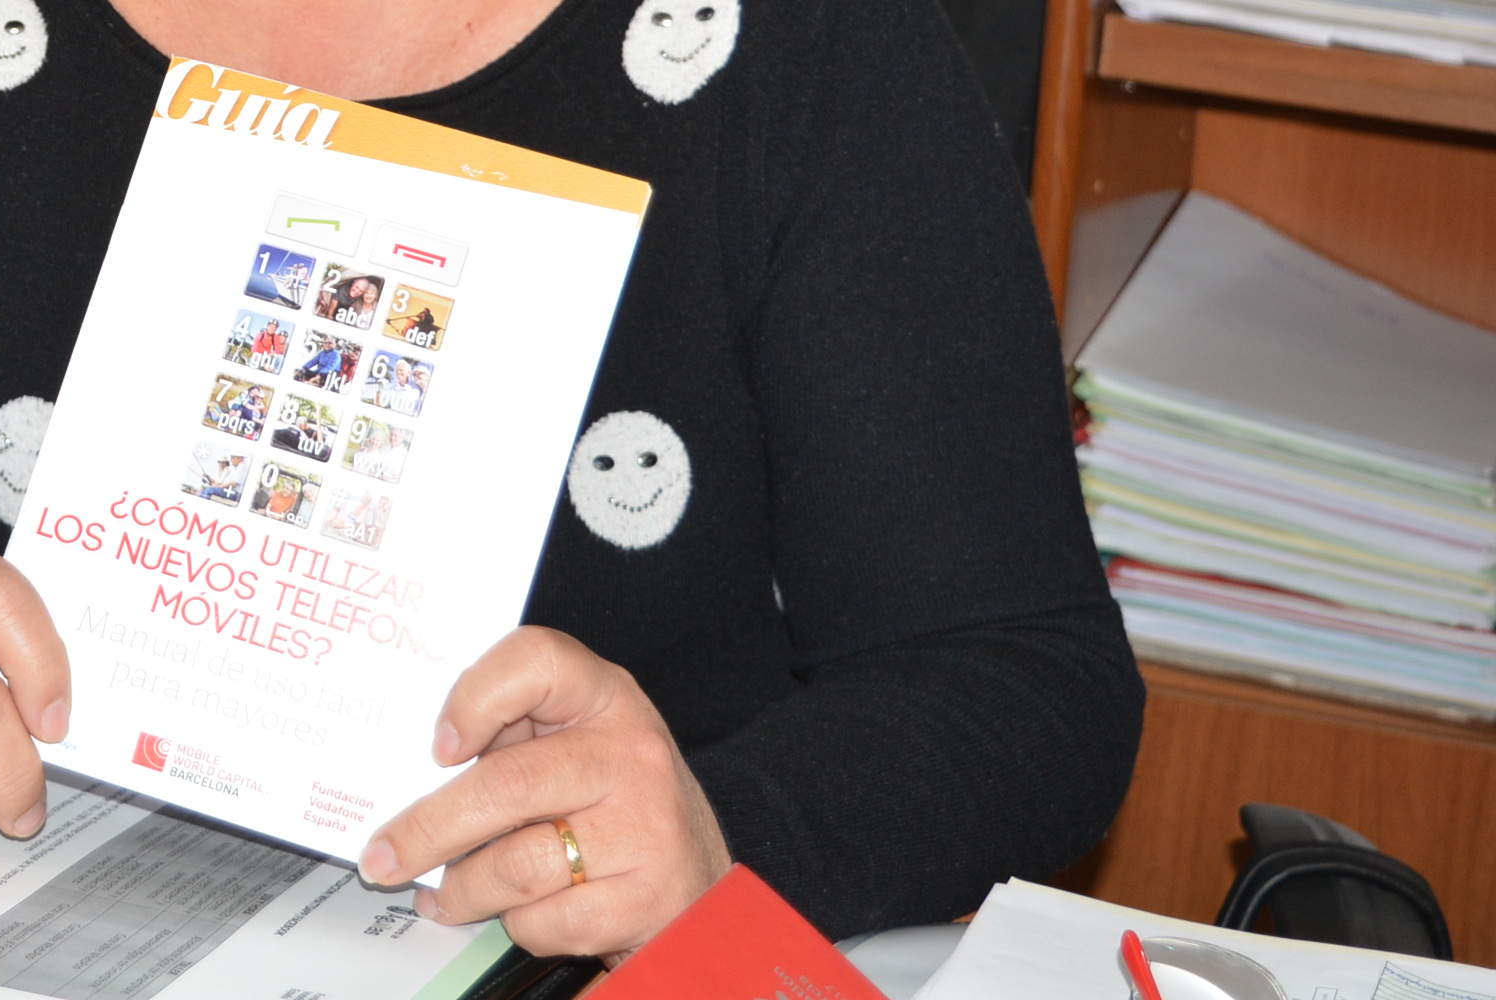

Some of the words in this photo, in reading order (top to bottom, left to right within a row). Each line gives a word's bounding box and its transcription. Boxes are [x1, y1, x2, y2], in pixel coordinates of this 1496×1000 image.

[155, 58, 341, 150] Guía
[259, 251, 271, 274] 1
[323, 269, 342, 293] 2
[392, 290, 410, 314] 3
[236, 315, 253, 339] 4
[336, 306, 368, 328] abc
[406, 326, 436, 349] def
[372, 354, 389, 379] 6
[214, 379, 233, 402] 7
[323, 371, 352, 393] jkl
[281, 399, 299, 423] 8
[217, 413, 256, 436] pqrs
[350, 420, 367, 444] 9
[298, 434, 325, 456] tuv
[262, 464, 279, 488] 0
[36, 507, 106, 552] LOS
[115, 531, 259, 600] NUEVOS
[110, 489, 246, 554] ¿CÓMO
[259, 535, 426, 613] UTILIZAR
[151, 585, 333, 666] MÓVILES?
[77, 606, 202, 668] Manual
[207, 648, 245, 681] de
[254, 668, 308, 702] uso
[109, 660, 182, 701] para
[191, 685, 328, 747] mayores
[173, 755, 215, 776] WORLD
[176, 743, 221, 766] MOBILE
[169, 766, 240, 798] BARCELONA
[311, 781, 374, 810] Fundación
[309, 796, 365, 822] Vodafone
[303, 811, 347, 833] España
